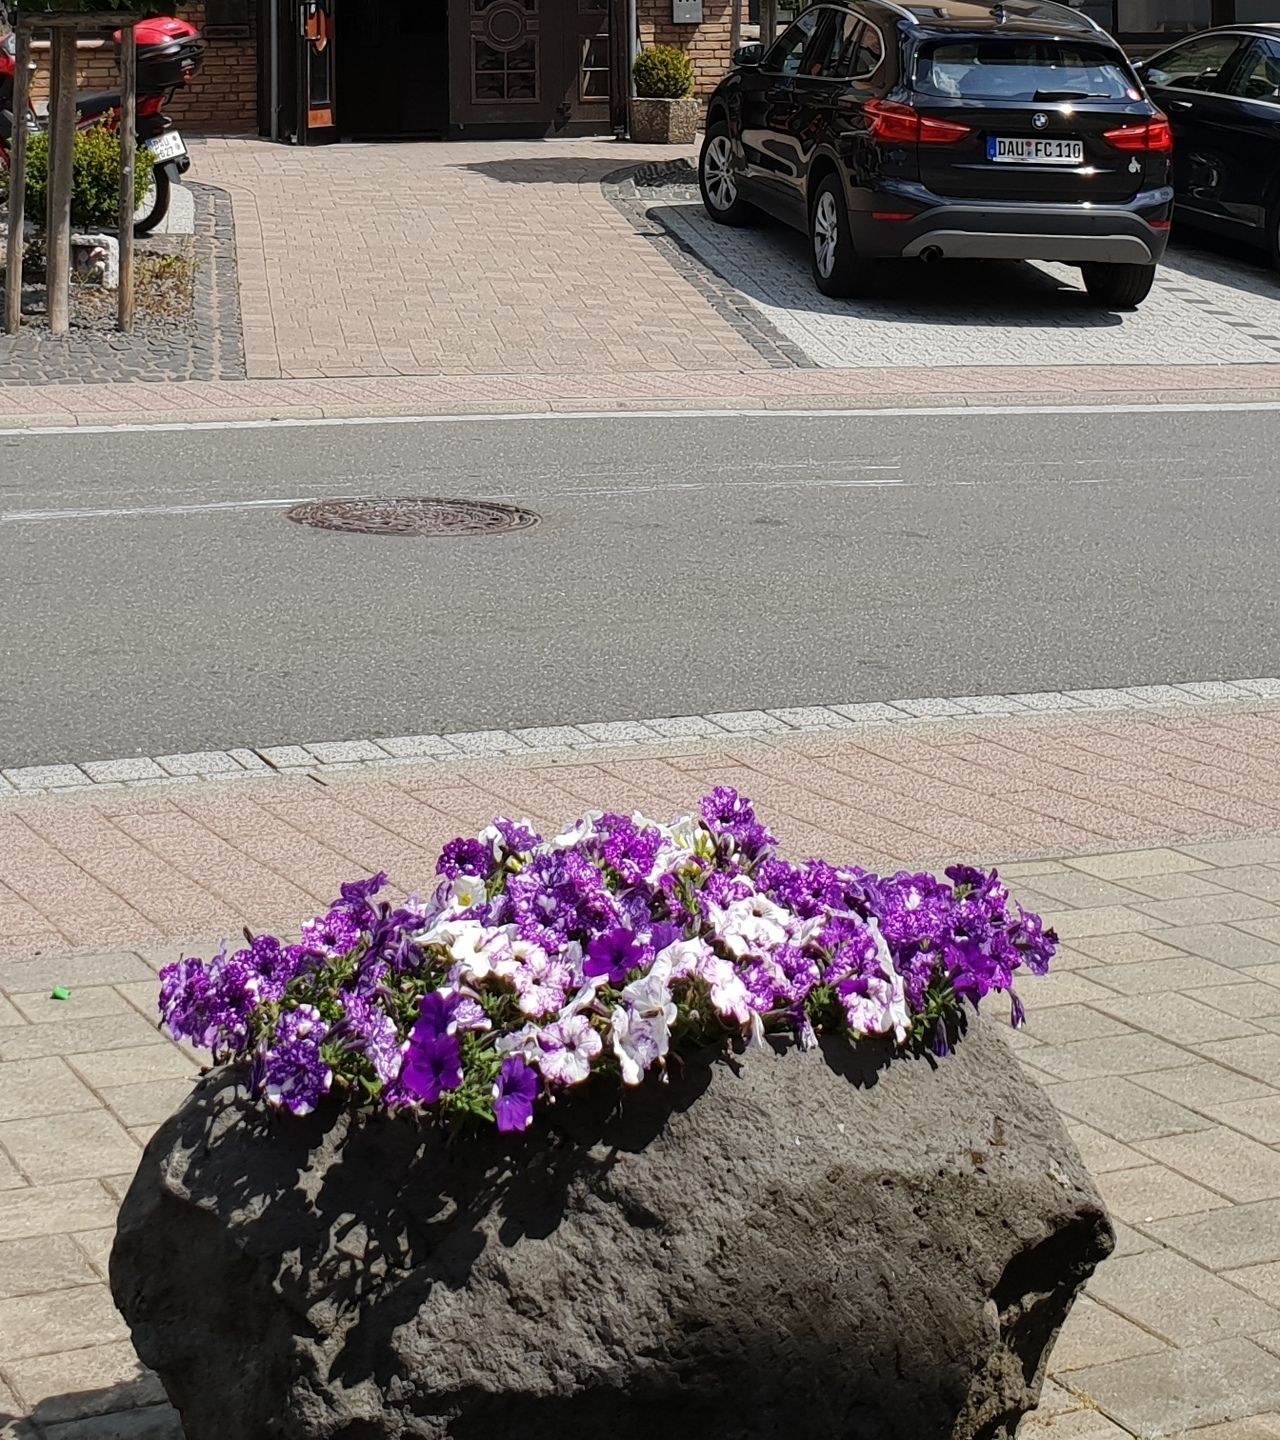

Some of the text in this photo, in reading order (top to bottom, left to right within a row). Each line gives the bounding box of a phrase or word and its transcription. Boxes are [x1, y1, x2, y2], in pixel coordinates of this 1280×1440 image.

[998, 140, 1081, 158] DAU FC 110
